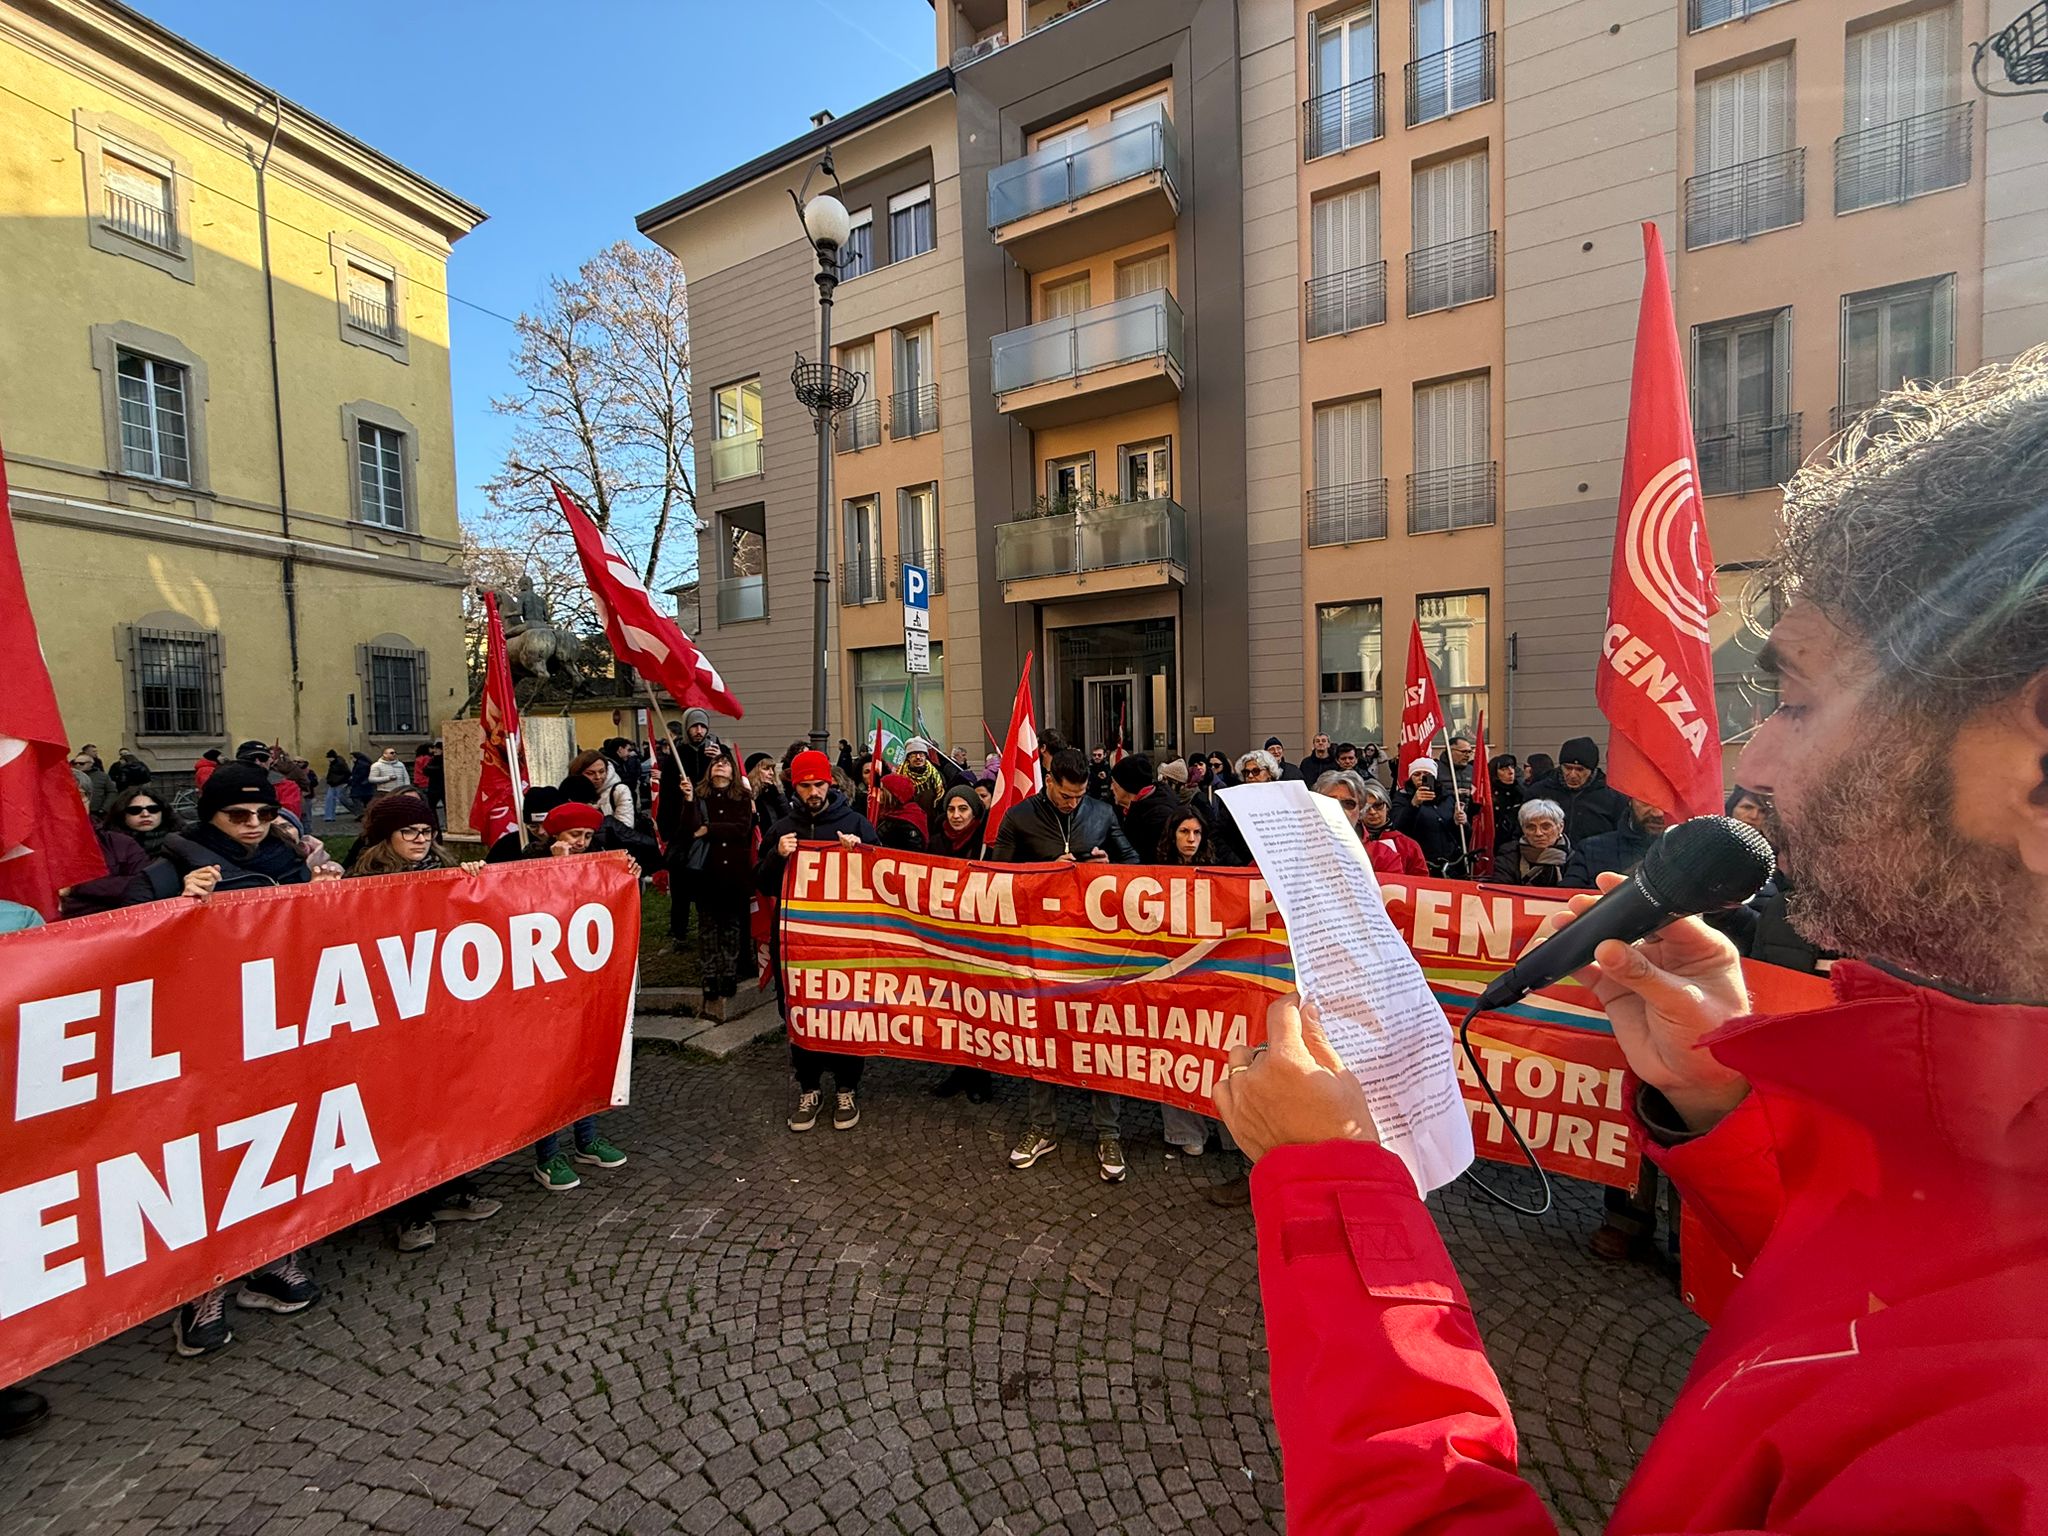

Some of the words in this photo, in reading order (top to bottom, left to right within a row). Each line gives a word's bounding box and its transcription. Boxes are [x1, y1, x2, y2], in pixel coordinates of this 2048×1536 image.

[909, 570, 924, 603] P
[1603, 607, 1709, 759] CENZA
[794, 851, 1018, 925] FILCTEM
[1085, 875, 1223, 936] CGIL
[242, 902, 614, 1062] LAVORO
[787, 967, 1038, 1030] FEDERAZIONE
[1055, 1001, 1247, 1052] ITALIANA
[1454, 1042, 1625, 1111] ATORI
[790, 1006, 923, 1046] CHIMICI
[937, 1018, 1057, 1069] TESSILI
[1463, 1098, 1630, 1169] TTURE
